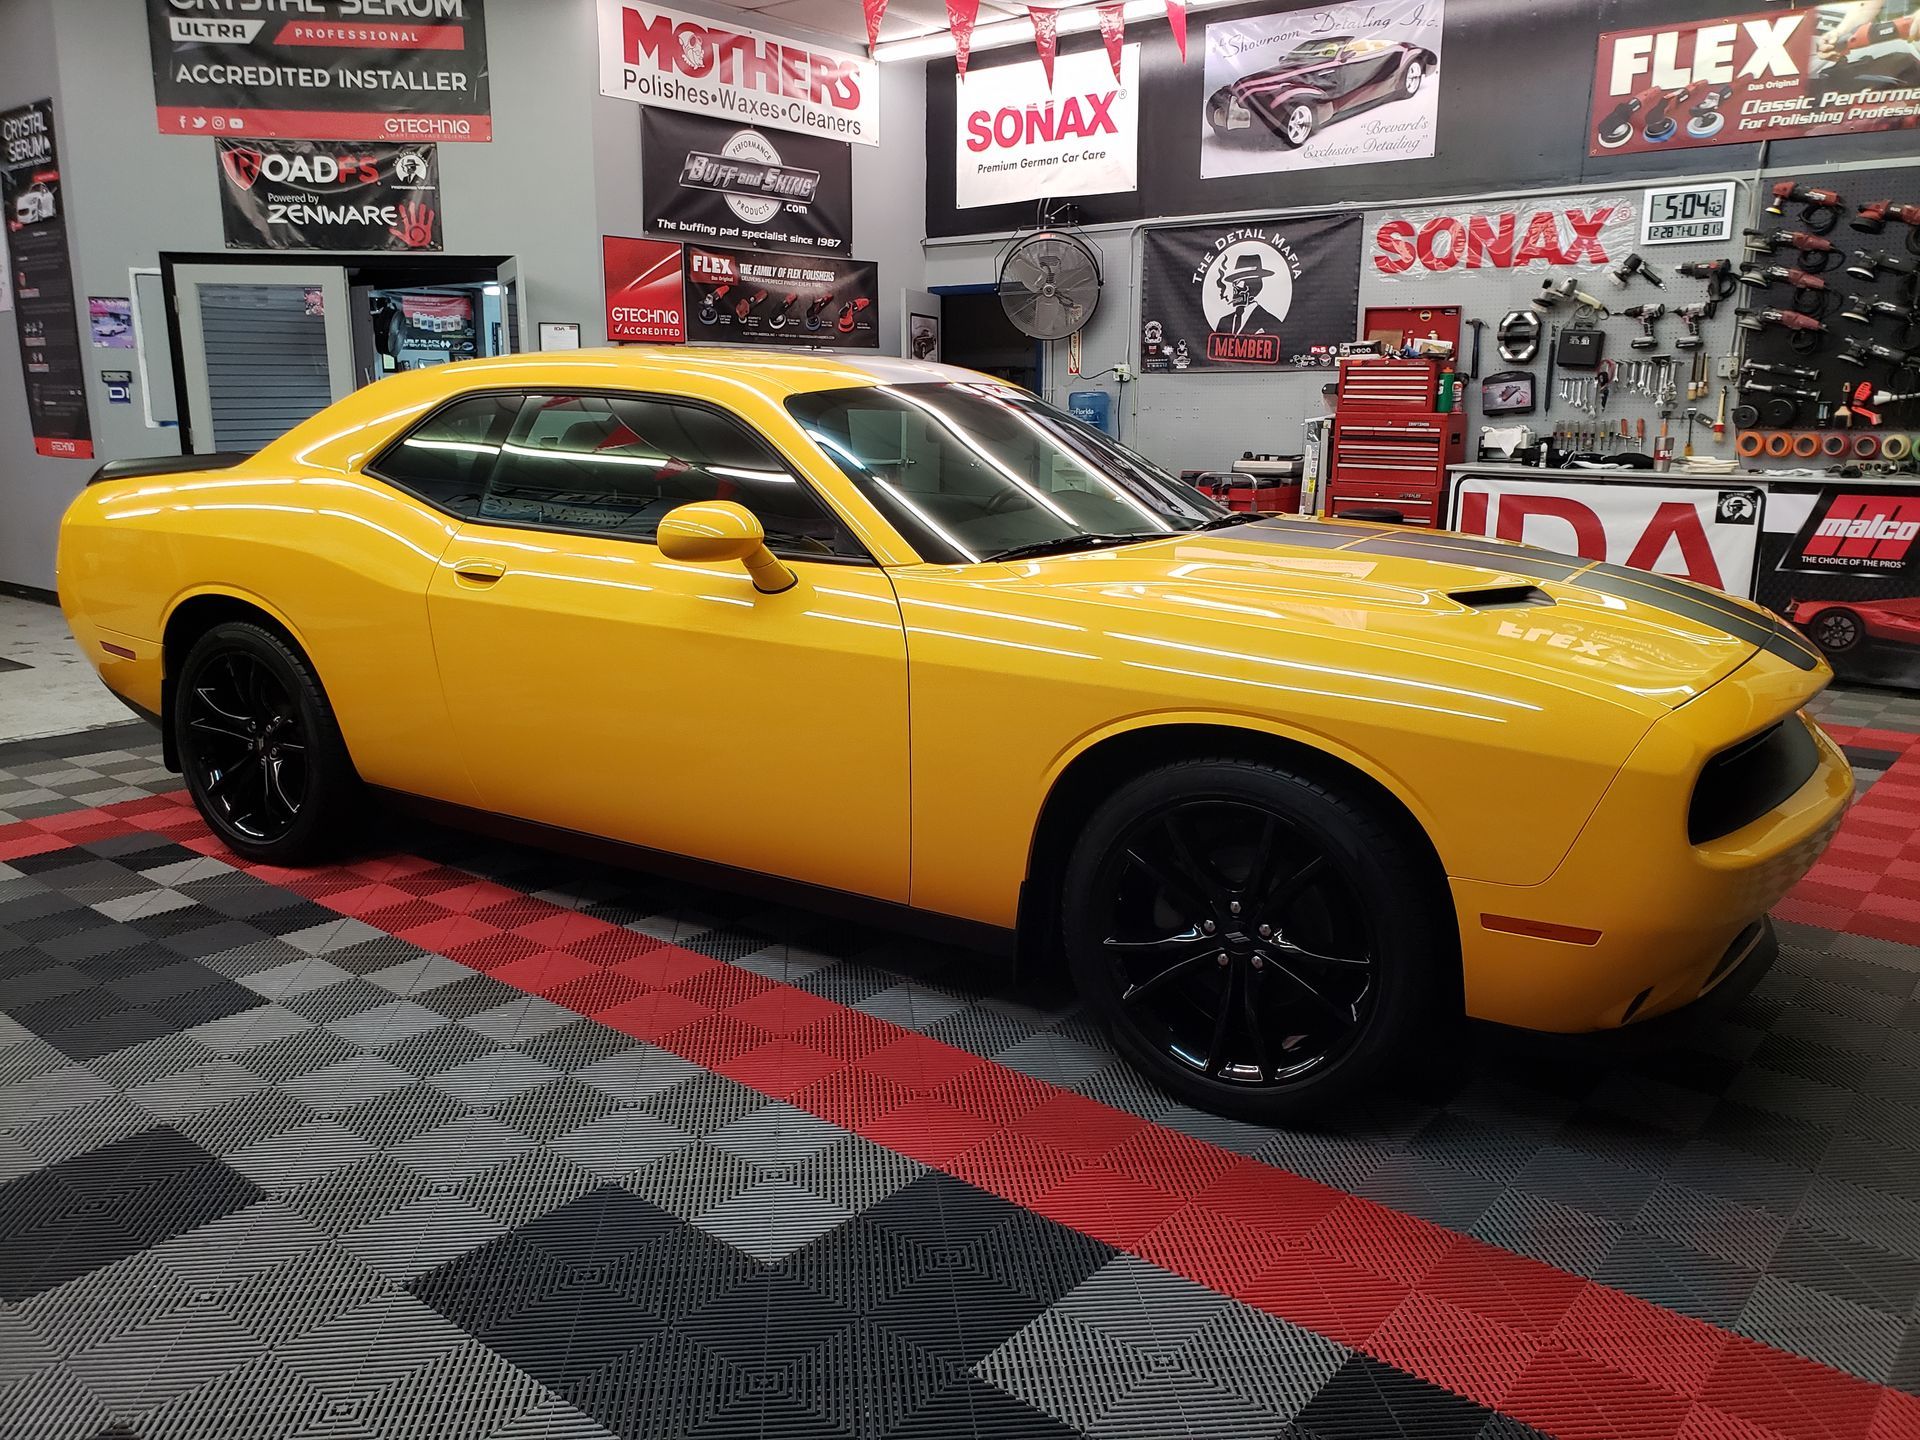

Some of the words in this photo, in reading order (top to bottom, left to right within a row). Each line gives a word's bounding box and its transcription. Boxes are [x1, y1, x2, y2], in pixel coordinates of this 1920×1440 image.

[178, 22, 247, 38] ULTRA
[295, 28, 418, 42] PROFESSIONAL
[622, 7, 861, 111] MOTHERS
[1609, 15, 1805, 96] FLEX
[176, 63, 330, 88] ACCREDITED
[339, 69, 467, 92] INSTALLER
[1747, 83, 1764, 91] Das
[1765, 79, 1800, 89] Original
[1741, 95, 1816, 115] Classic
[3, 111, 48, 141] CRYSTAL
[385, 118, 470, 134] GTECHNIQ
[1738, 118, 1766, 130] For
[1768, 111, 1844, 127] Polishing
[9, 134, 45, 163] SERUM
[731, 140, 772, 162] PERFORMANCE
[1303, 143, 1359, 160] Exclusive
[977, 159, 1018, 174] Premium
[1020, 155, 1058, 168] German
[1062, 152, 1079, 163] Car
[1082, 150, 1106, 161] Care
[688, 156, 738, 187] BUFF
[737, 171, 763, 187] and
[762, 168, 816, 197] SHINE
[268, 192, 306, 204] Powered
[306, 193, 319, 205] by
[736, 199, 770, 216] PRODUCTS
[783, 203, 808, 214] .com
[1665, 193, 1711, 220] 5:04
[267, 204, 398, 226] ZENWARE
[657, 218, 677, 230] The
[679, 219, 717, 236] buffing
[719, 226, 739, 238] pad
[742, 229, 787, 242] specialist
[789, 233, 813, 245] since
[817, 237, 842, 248] 1987
[1374, 207, 1617, 273] SONAX
[693, 255, 733, 275] FLEX
[1192, 252, 1214, 284] THE
[1215, 228, 1266, 250] DETAIL
[1271, 233, 1302, 280] MAFIA
[739, 263, 752, 275] THE
[752, 265, 777, 277] FAMILY
[777, 267, 787, 278] OF
[787, 268, 802, 280] FLEX
[802, 269, 835, 282] POLISHERS
[611, 307, 679, 324] GTECHNIQ
[623, 326, 681, 336] ACCREDITED
[1214, 337, 1273, 360] MEMBER
[1815, 513, 1920, 541] malco
[1801, 555, 1817, 564] THE
[1818, 556, 1848, 566] CHOICE
[1849, 558, 1861, 566] OF
[1862, 559, 1878, 568] THE
